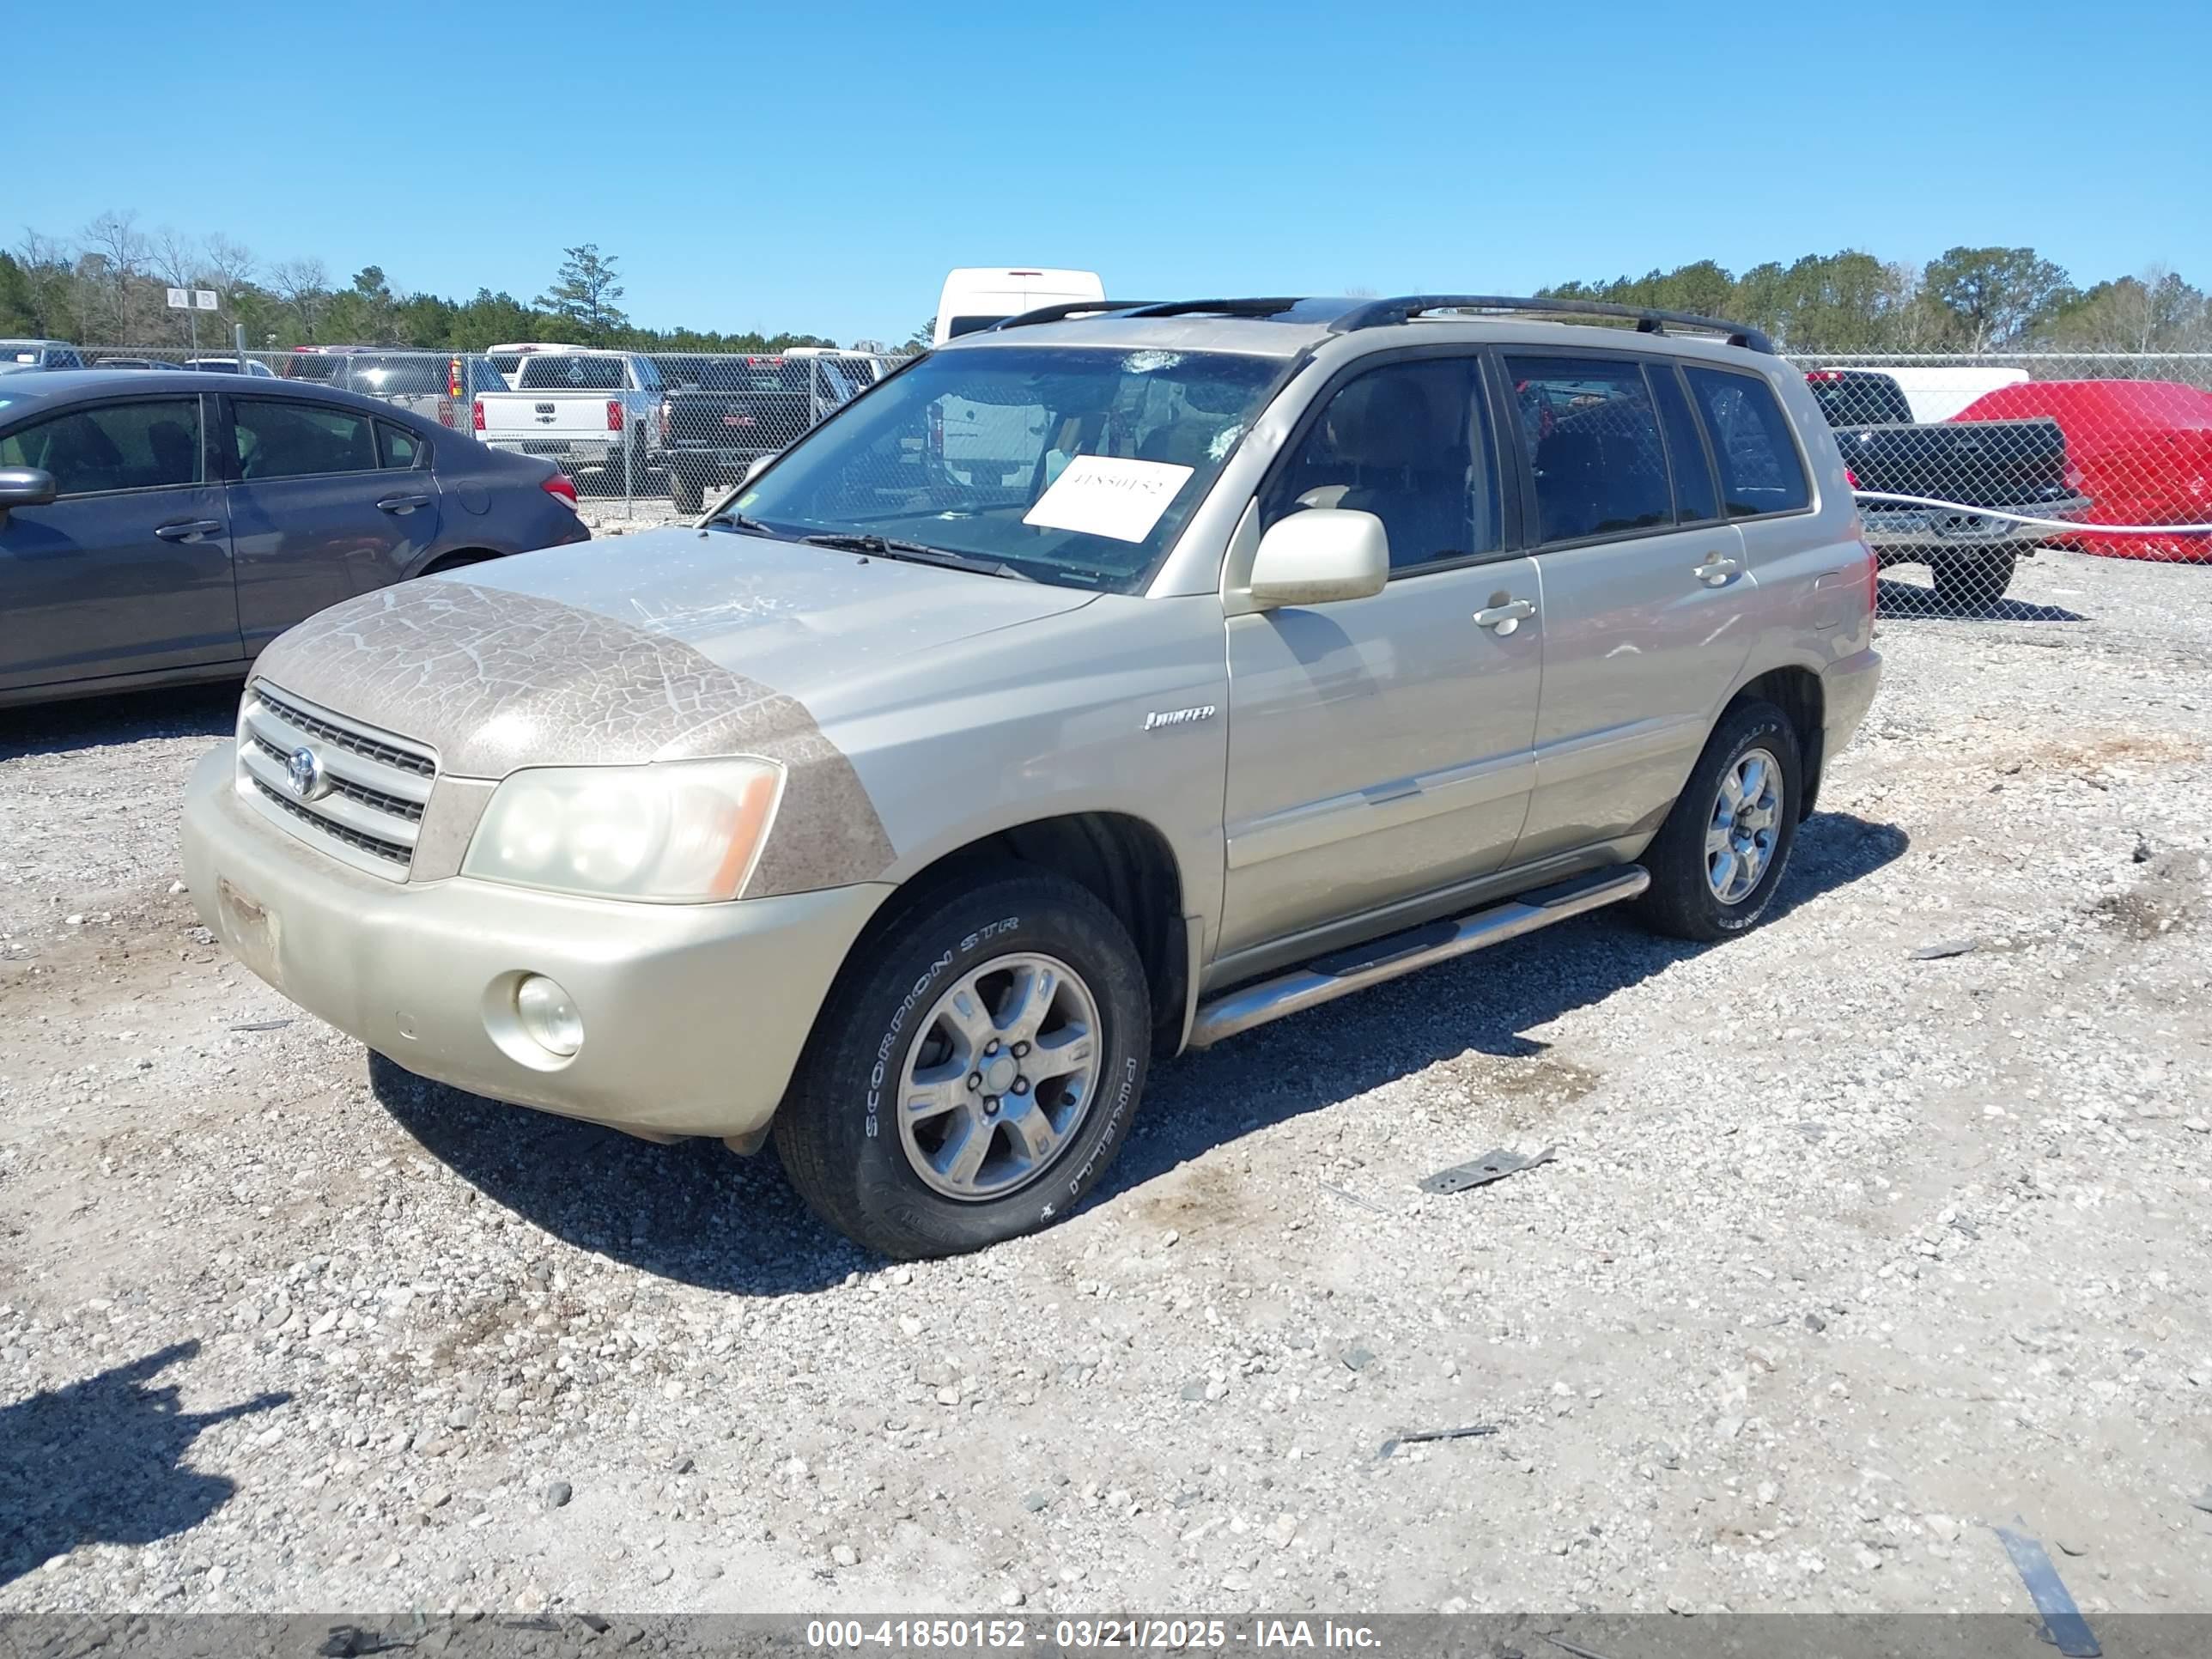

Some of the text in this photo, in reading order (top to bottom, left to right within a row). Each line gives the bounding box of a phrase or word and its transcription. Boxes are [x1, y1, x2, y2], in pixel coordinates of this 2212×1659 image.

[171, 291, 185, 305] A
[201, 293, 214, 306] B
[1144, 705, 1216, 731] LIMITED
[866, 916, 1019, 1138] SCORPION STR
[1067, 1056, 1137, 1197] PIRELLI
